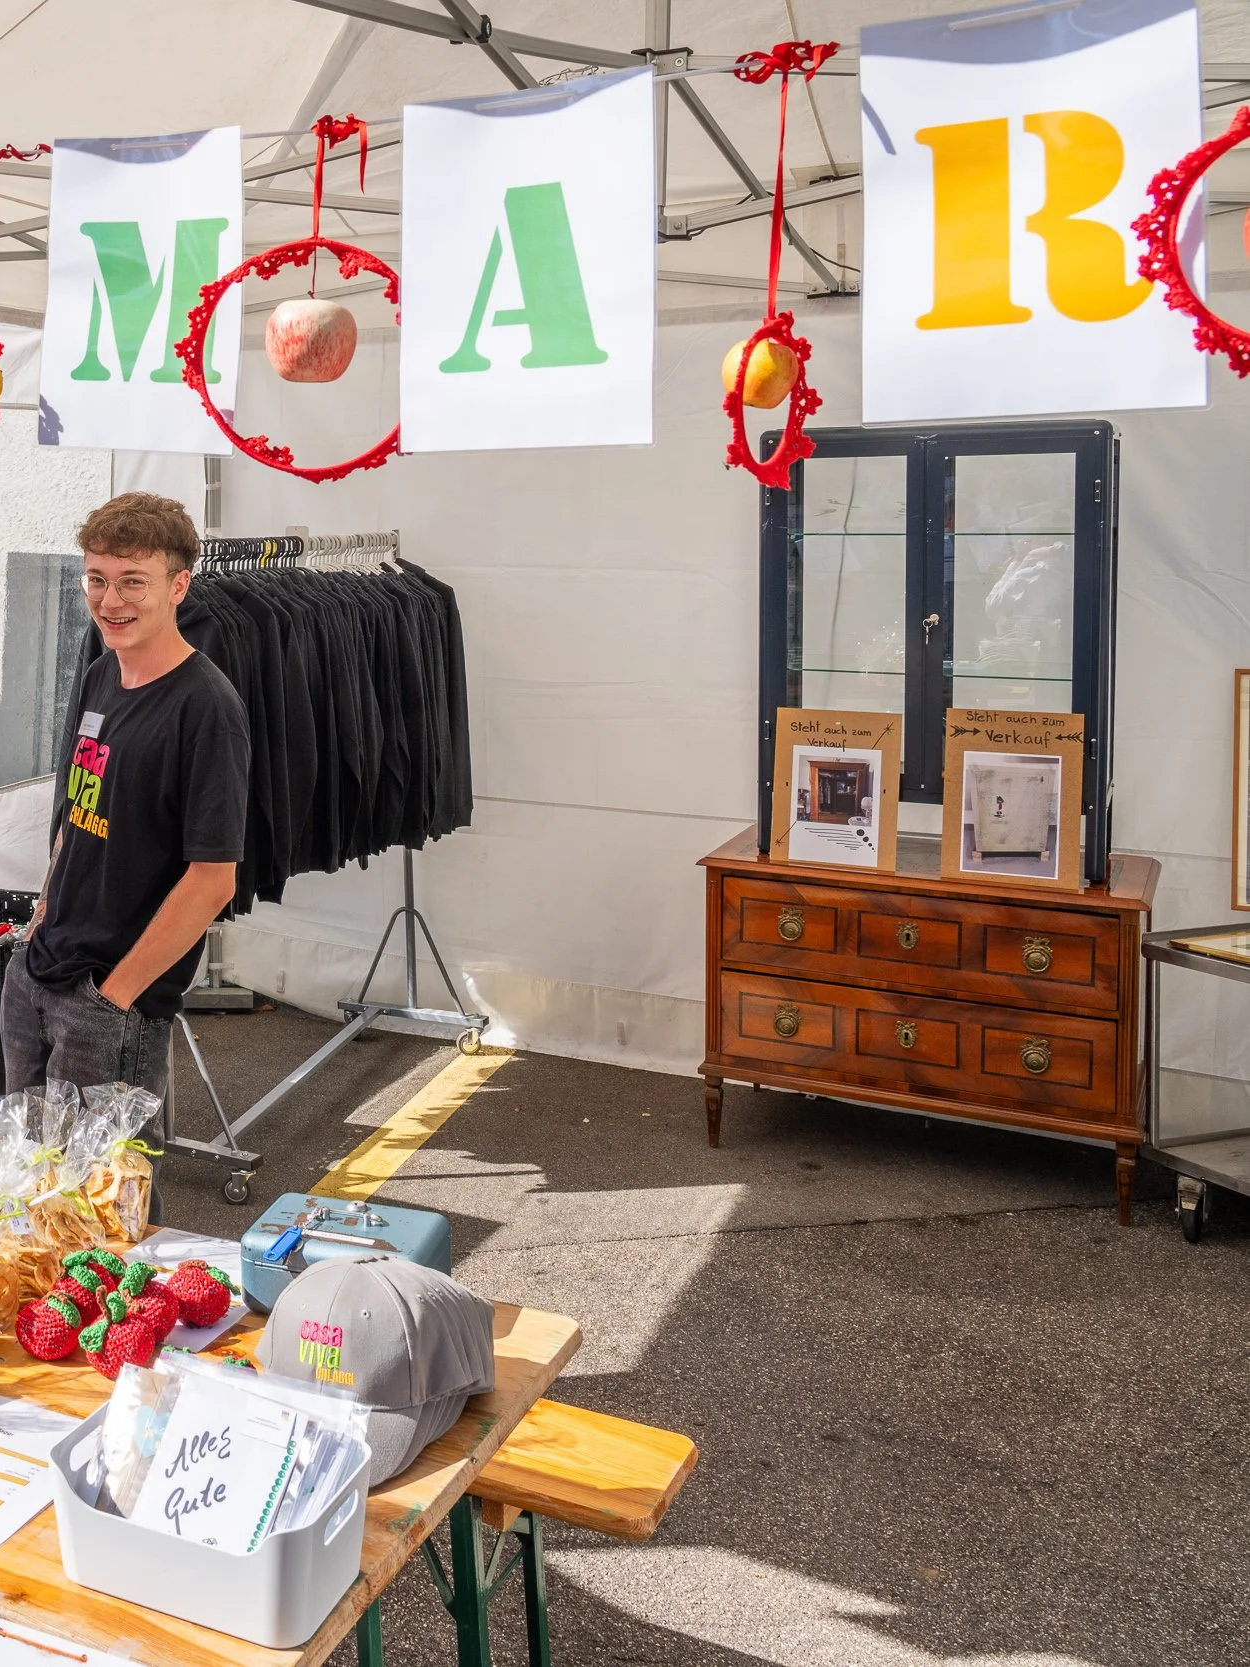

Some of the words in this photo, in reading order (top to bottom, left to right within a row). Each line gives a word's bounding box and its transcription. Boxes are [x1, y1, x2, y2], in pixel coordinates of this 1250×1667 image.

[790, 721, 821, 733] Steht
[824, 725, 847, 735] auch
[852, 729, 872, 737] zum
[966, 710, 999, 722] Steht
[1005, 714, 1037, 724] auch
[1042, 717, 1065, 727] zum
[807, 737, 847, 752] Verkauf
[985, 729, 1051, 748] Verkauf
[299, 1319, 343, 1348] casa
[299, 1338, 341, 1369] viva
[165, 1426, 231, 1478] Alles
[164, 1477, 227, 1536] Gute
